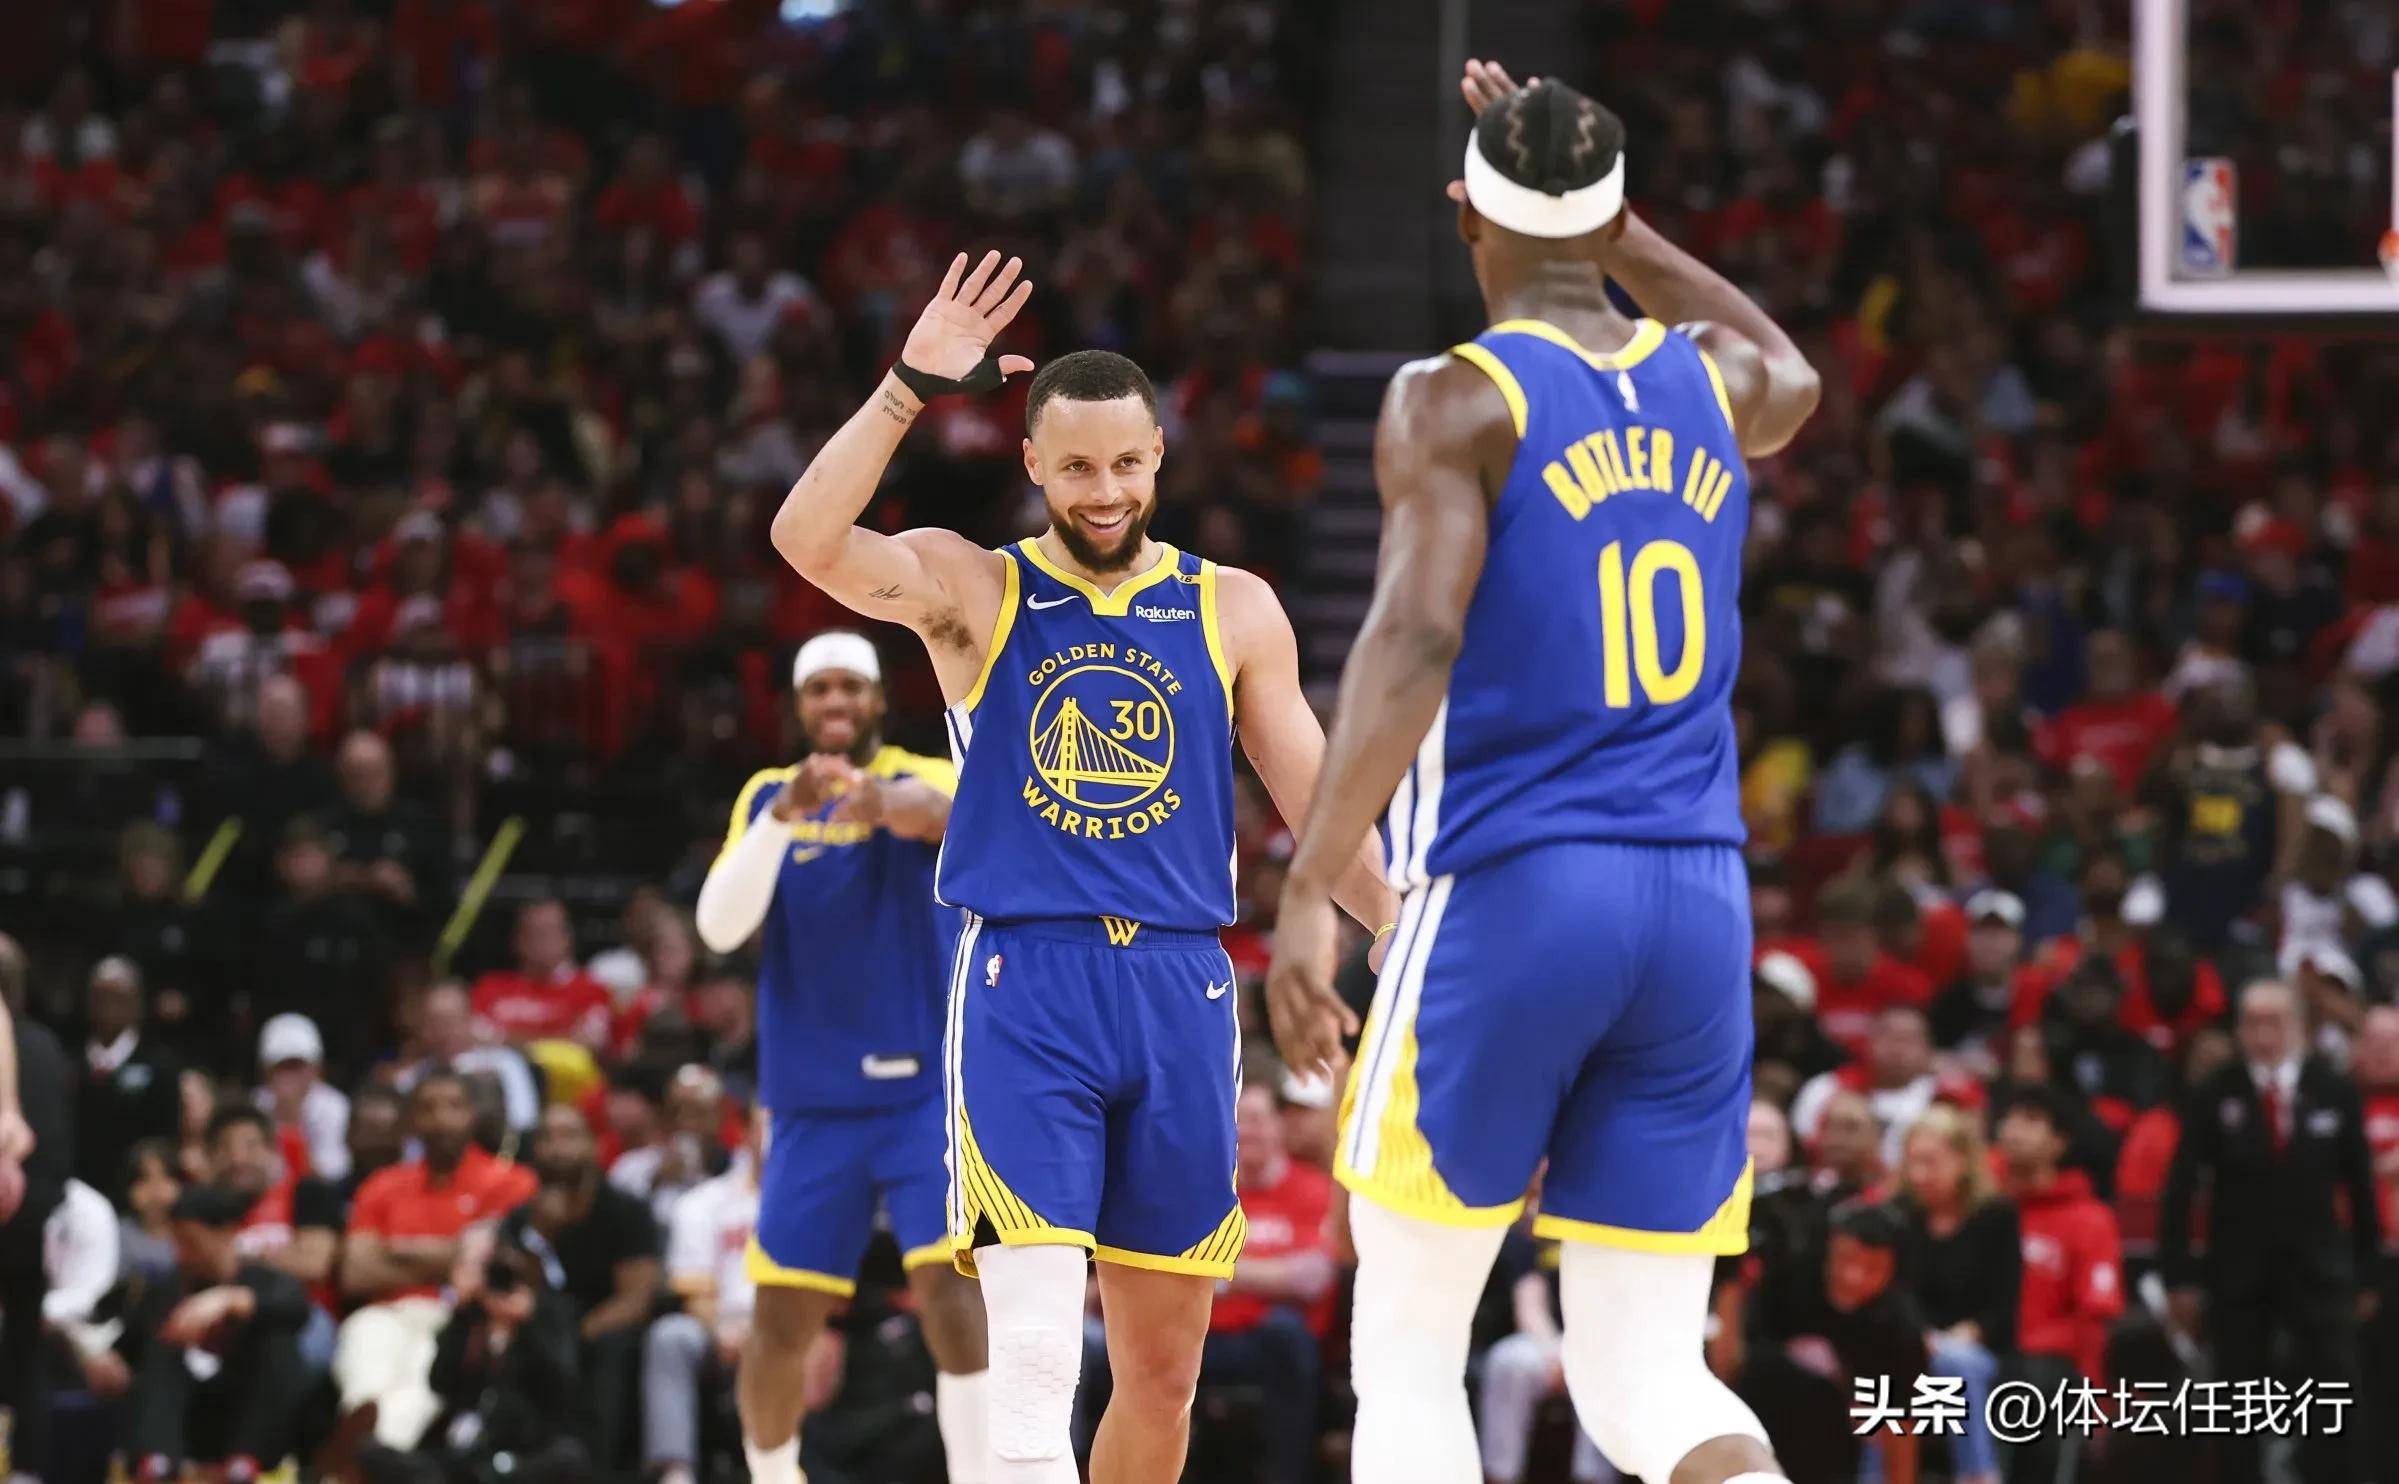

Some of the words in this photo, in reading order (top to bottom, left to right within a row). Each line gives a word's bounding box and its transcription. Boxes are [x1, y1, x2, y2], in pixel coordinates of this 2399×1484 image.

[1541, 425, 1674, 522] BUTLER
[1682, 446, 1733, 523] III
[1135, 604, 1196, 621] Rakuten
[1598, 539, 1706, 708] 10
[1028, 643, 1115, 686] GOLDEN
[1124, 648, 1183, 696] STATE
[1109, 700, 1161, 741] 30
[1022, 775, 1182, 840] WARRIORS
